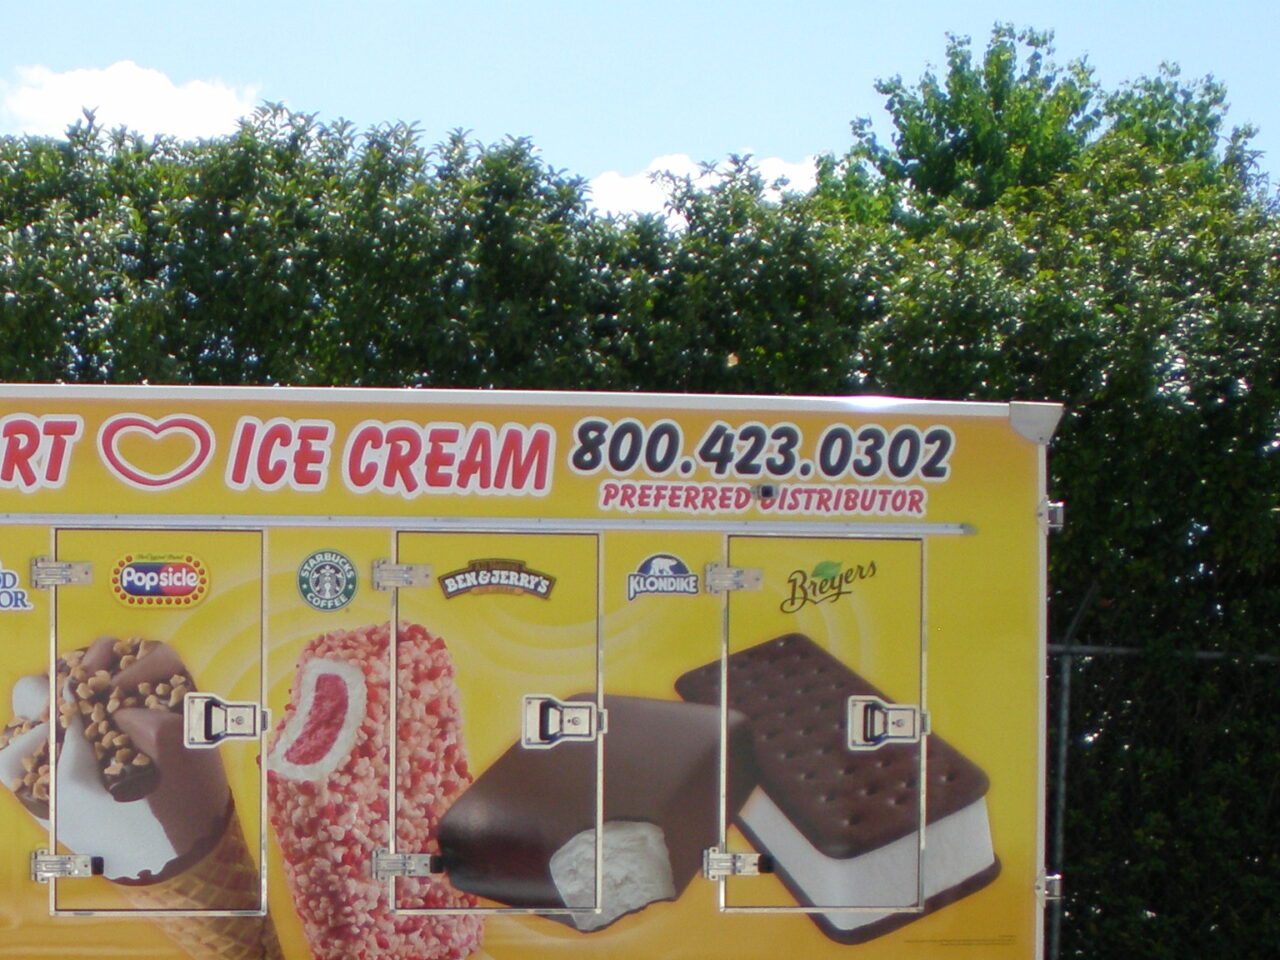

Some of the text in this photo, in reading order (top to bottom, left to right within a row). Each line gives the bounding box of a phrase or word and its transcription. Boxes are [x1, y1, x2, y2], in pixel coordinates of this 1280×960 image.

[231, 421, 330, 486] ICE
[347, 425, 551, 494] CREAM
[571, 419, 953, 479] 800.423.0302
[602, 482, 752, 511] PREFERRED
[122, 566, 198, 591] Popsicle
[301, 552, 354, 578] STARBUCKS
[306, 592, 348, 609] COFFEE
[628, 574, 698, 600] KLONDIKE
[780, 560, 877, 614] Breyers
